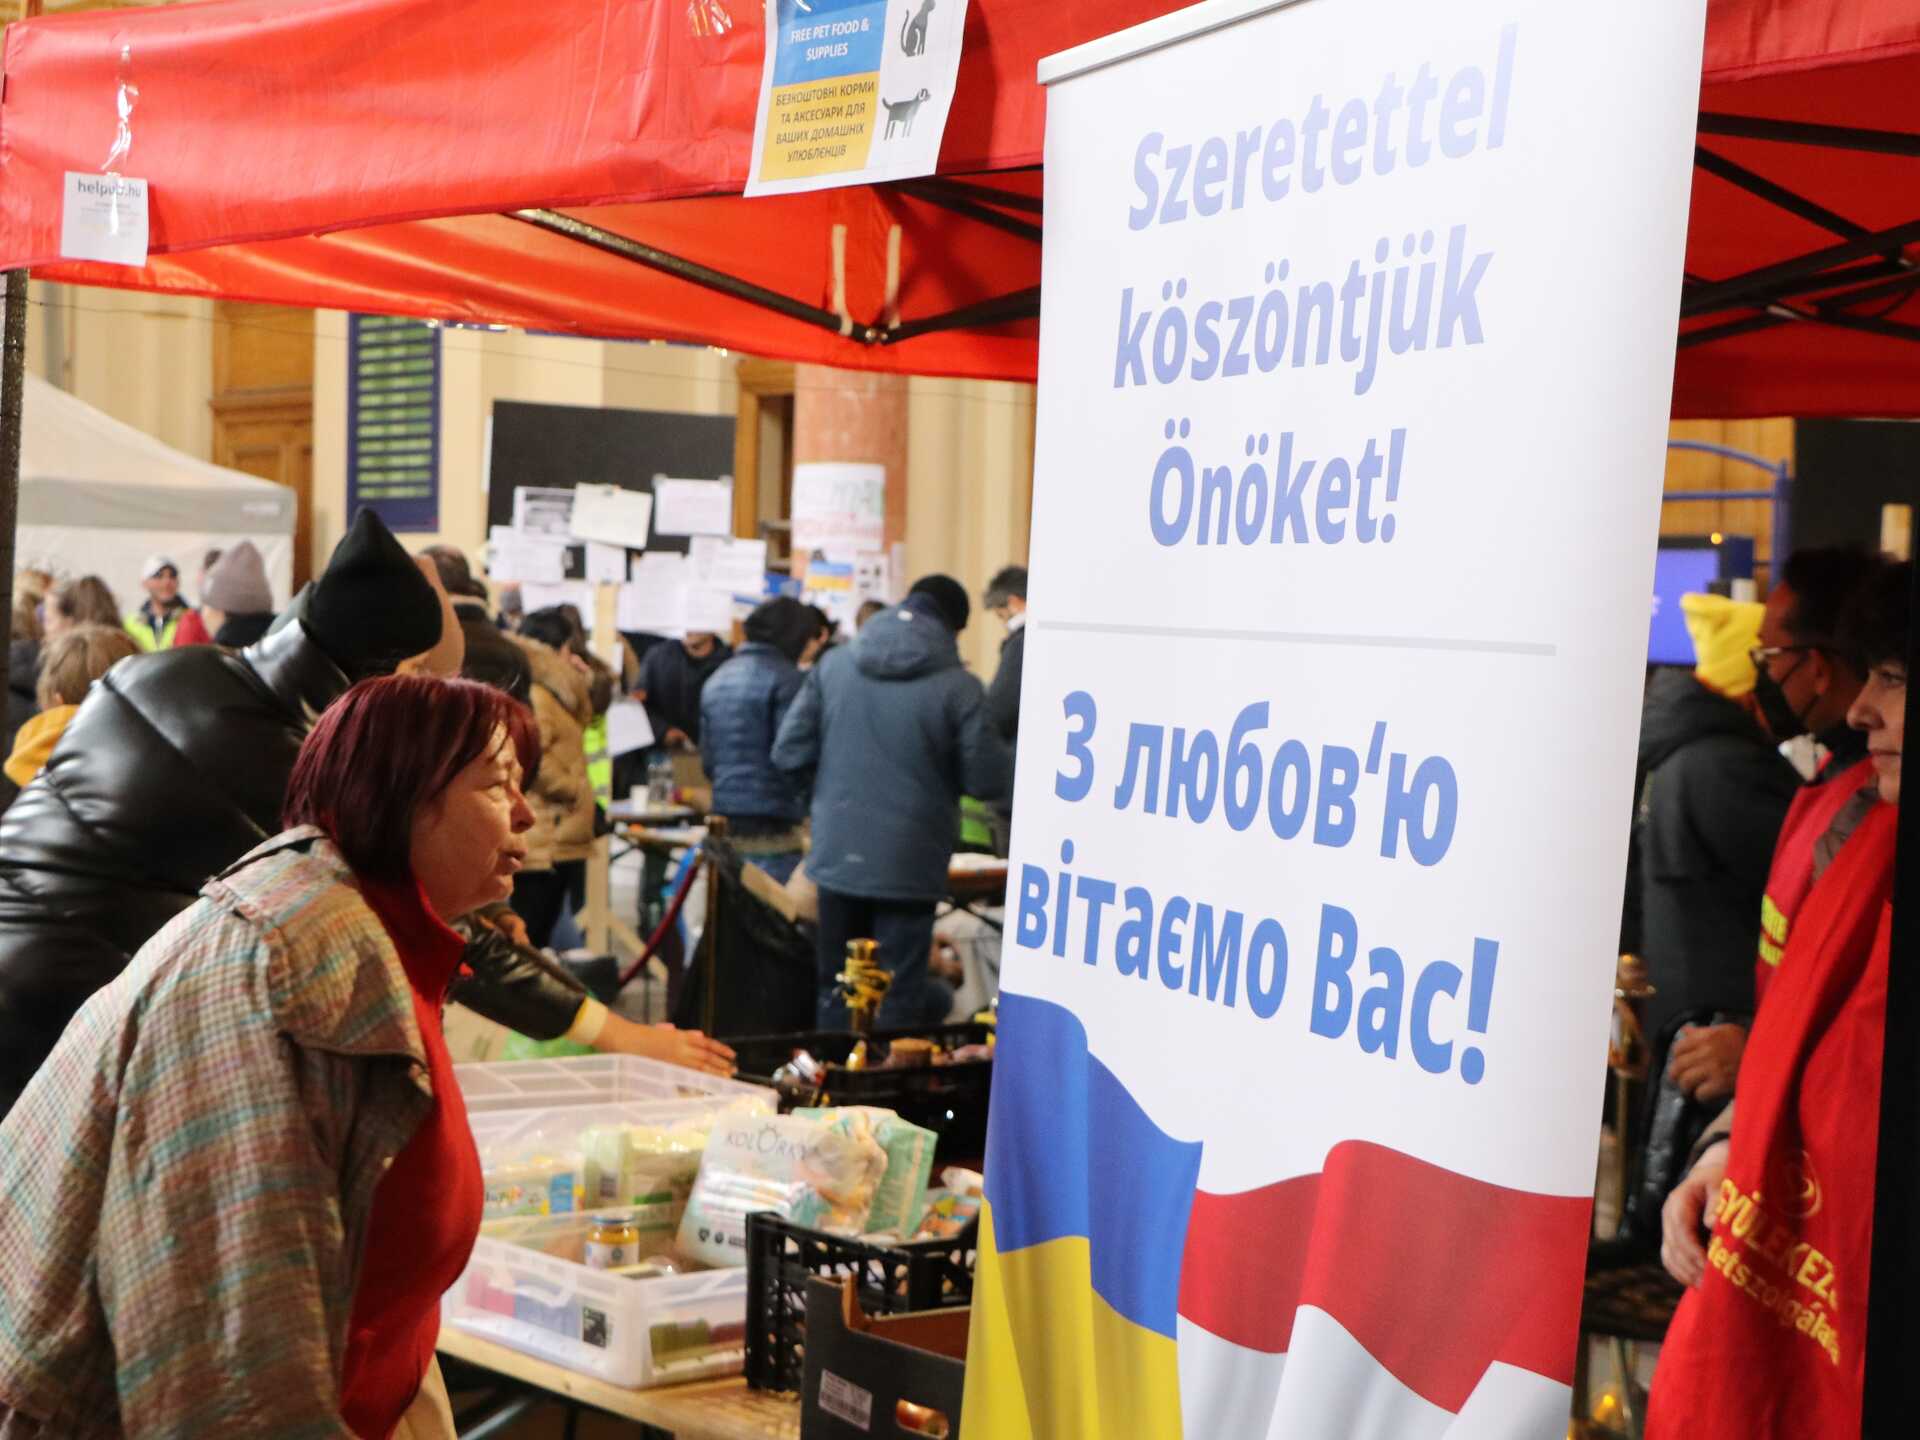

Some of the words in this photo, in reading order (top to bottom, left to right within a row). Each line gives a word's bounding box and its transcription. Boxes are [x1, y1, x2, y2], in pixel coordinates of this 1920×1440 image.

[791, 28, 812, 45] FREE
[813, 24, 831, 39] PET
[832, 20, 859, 36] FOOD
[861, 17, 870, 31] &
[806, 42, 848, 61] SUPPLIES
[776, 87, 837, 106] БЕЗКОШТОВНІ
[840, 81, 875, 97] КОРМИ
[781, 112, 791, 124] ТА
[793, 107, 844, 123] АКСЕСУАРИ
[845, 103, 865, 119] ДЛЯ
[1128, 22, 1518, 231] Szeretettel
[776, 130, 809, 144] ВАШИХ
[810, 123, 864, 142] ДОМАШНІХ
[787, 145, 847, 162] УЛЮБЛЕНЦІВ
[1114, 223, 1495, 395] köszöntjük
[1149, 417, 1407, 547] Önöket!
[1054, 690, 1098, 802] З
[1016, 838, 1289, 1020] вітаємо
[1309, 903, 1500, 1086] Вас!
